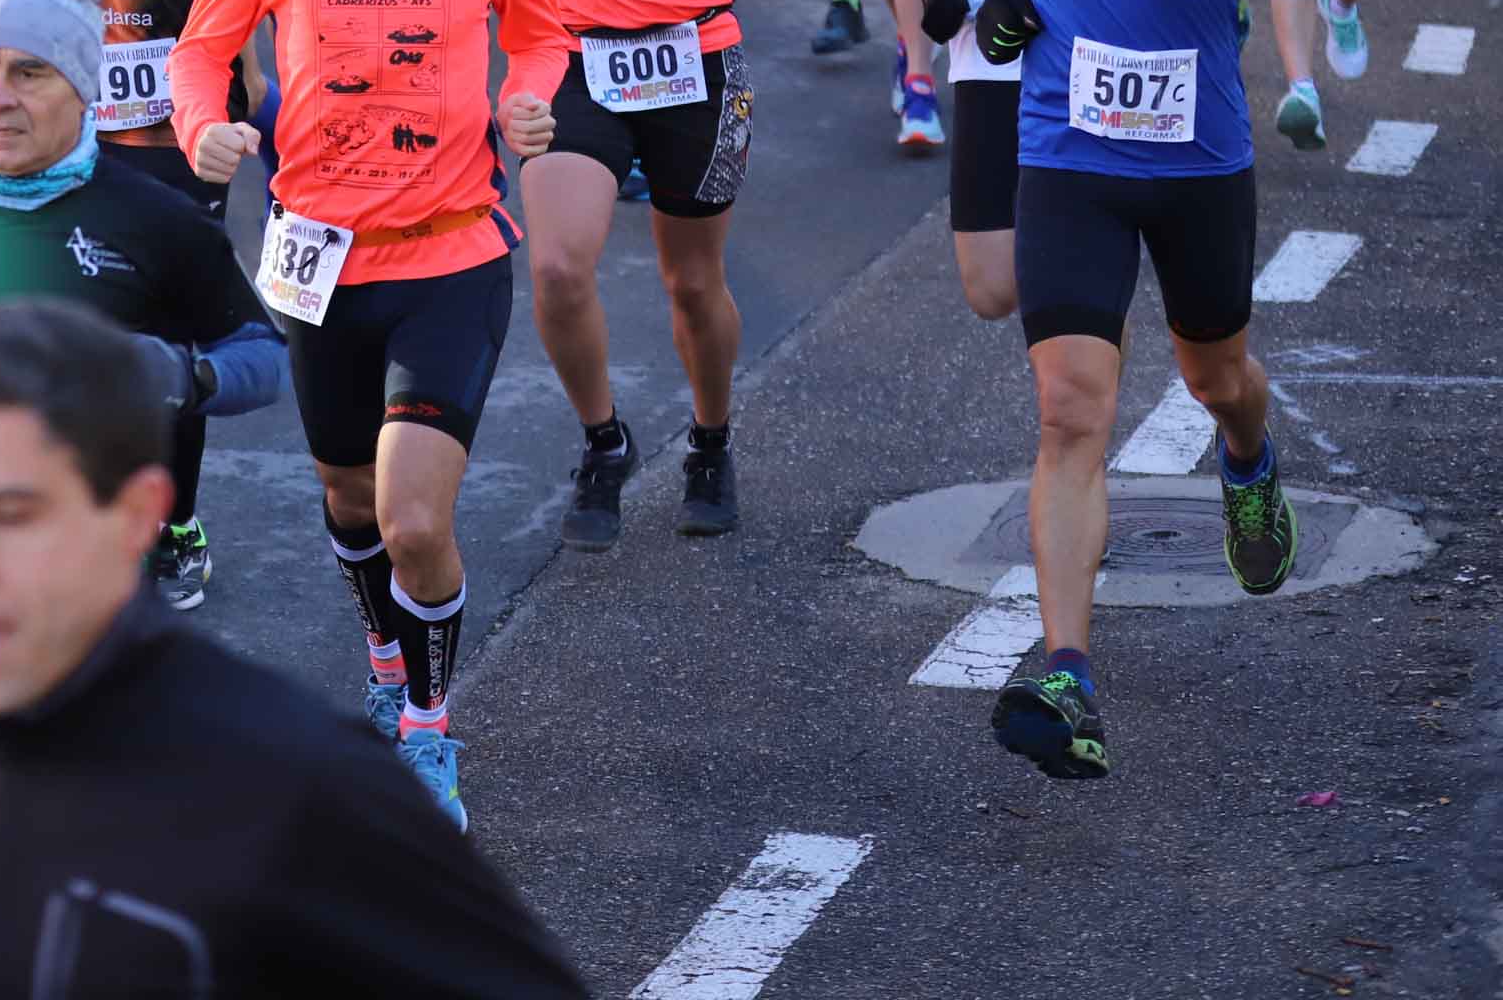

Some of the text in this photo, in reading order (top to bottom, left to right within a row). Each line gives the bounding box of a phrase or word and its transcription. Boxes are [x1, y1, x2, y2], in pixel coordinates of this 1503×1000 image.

[101, 7, 153, 26] darsa
[609, 43, 678, 85] 600
[98, 64, 156, 102] 90
[600, 77, 697, 103] JOMISAGA
[1094, 68, 1170, 110] 507
[1077, 104, 1185, 131] JOMISAGA
